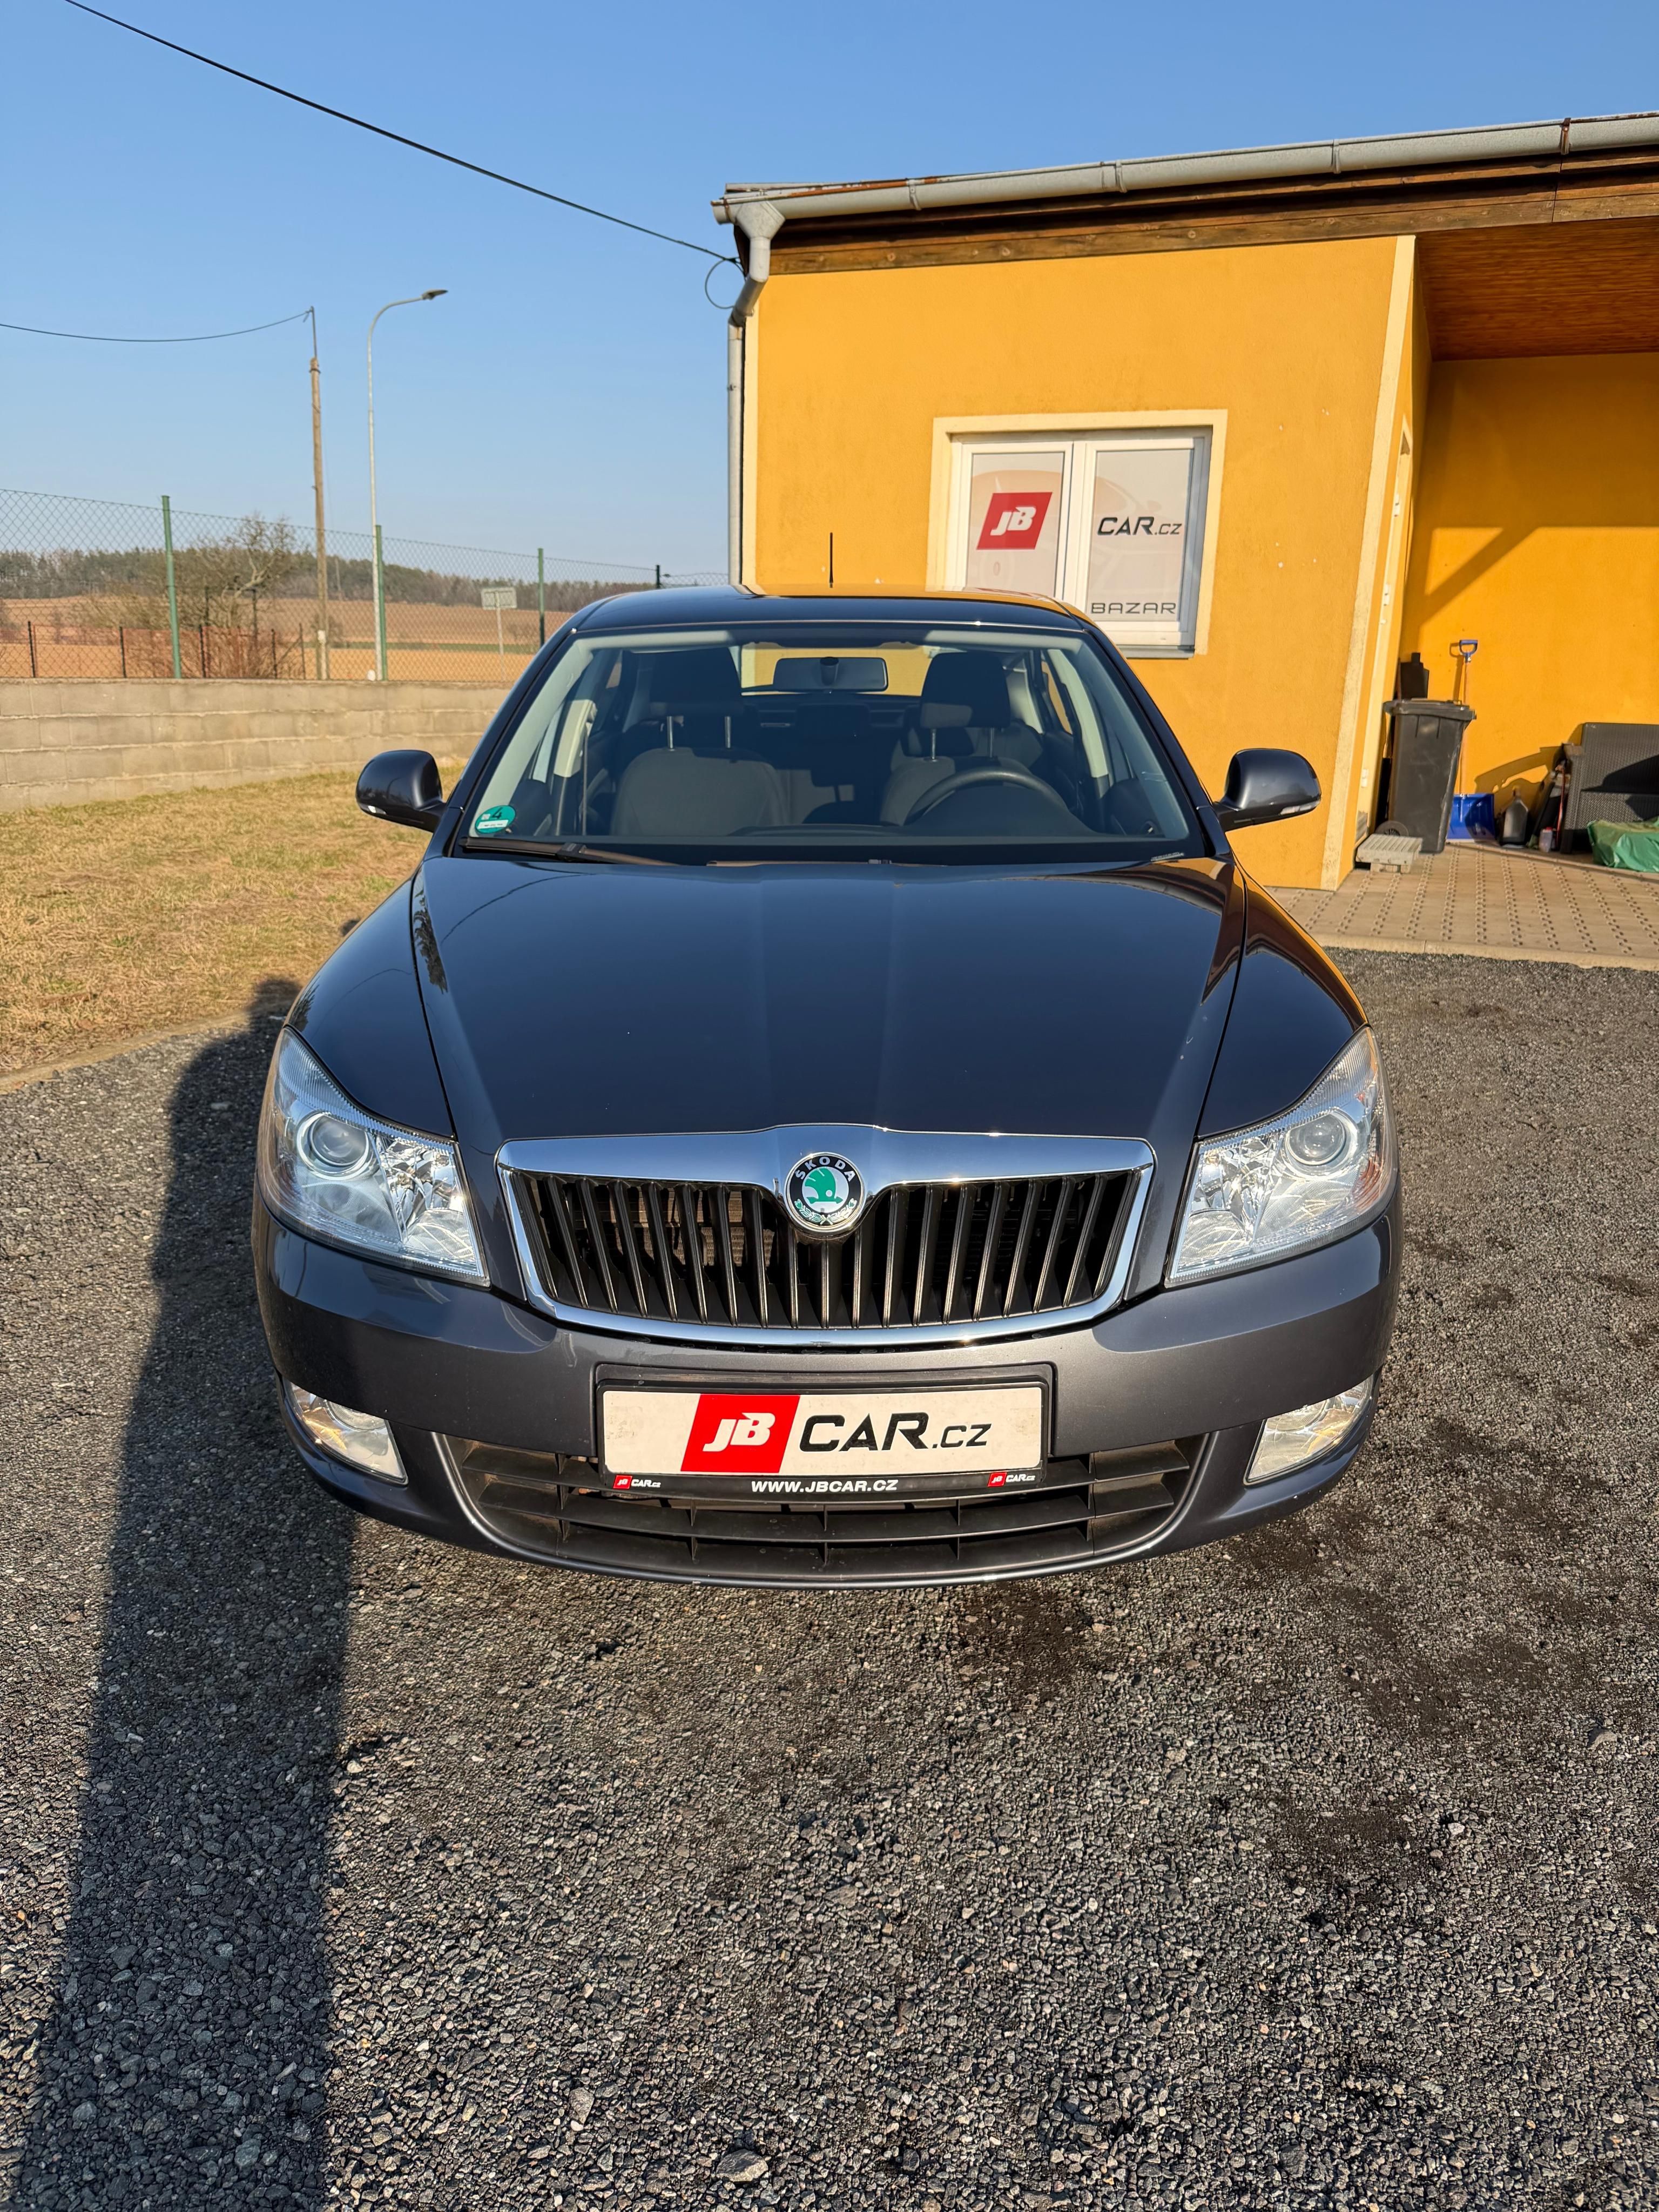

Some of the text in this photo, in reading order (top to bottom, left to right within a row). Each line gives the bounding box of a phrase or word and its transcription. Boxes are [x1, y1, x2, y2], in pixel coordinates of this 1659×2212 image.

[990, 507, 1036, 536] JB
[1091, 603, 1176, 614] BAZAR
[493, 807, 503, 819] 4
[703, 1412, 775, 1452] JB
[751, 1480, 899, 1492] WWW.JBCAR.CZ
